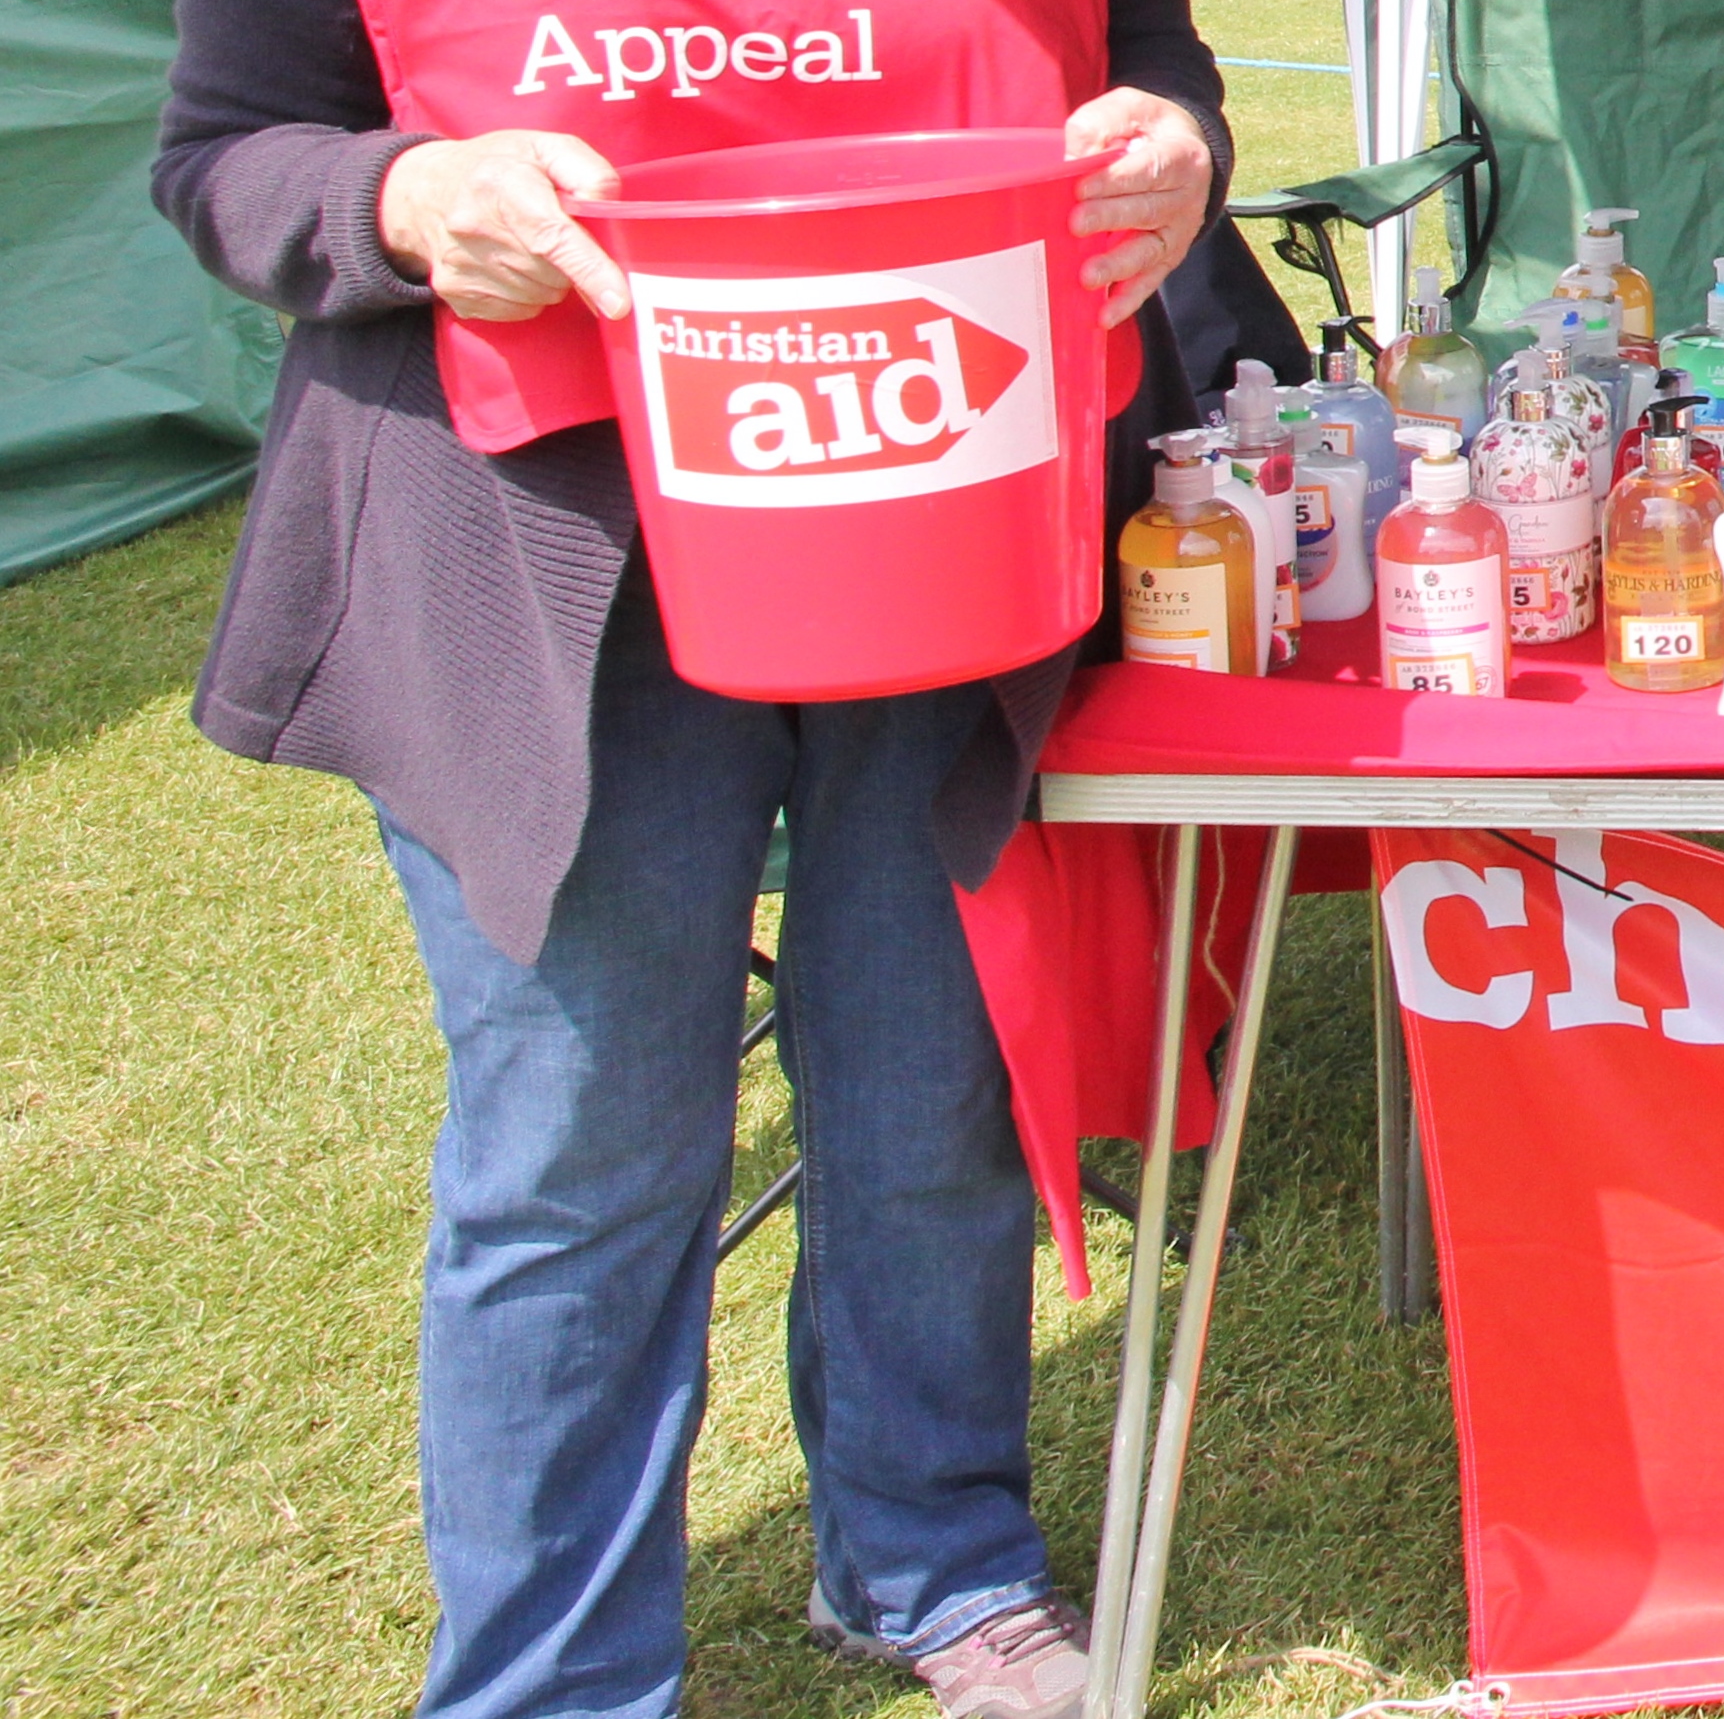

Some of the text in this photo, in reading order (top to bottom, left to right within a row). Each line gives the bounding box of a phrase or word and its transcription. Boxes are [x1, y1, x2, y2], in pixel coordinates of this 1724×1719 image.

[512, 7, 884, 103] Appeal
[653, 315, 892, 365] christian
[726, 316, 984, 472] aid
[1394, 586, 1475, 601] BAYLEY'S
[1648, 581, 1661, 592] &
[1437, 602, 1475, 613] STREET
[1633, 634, 1693, 656] 120
[1411, 674, 1453, 692] 85
